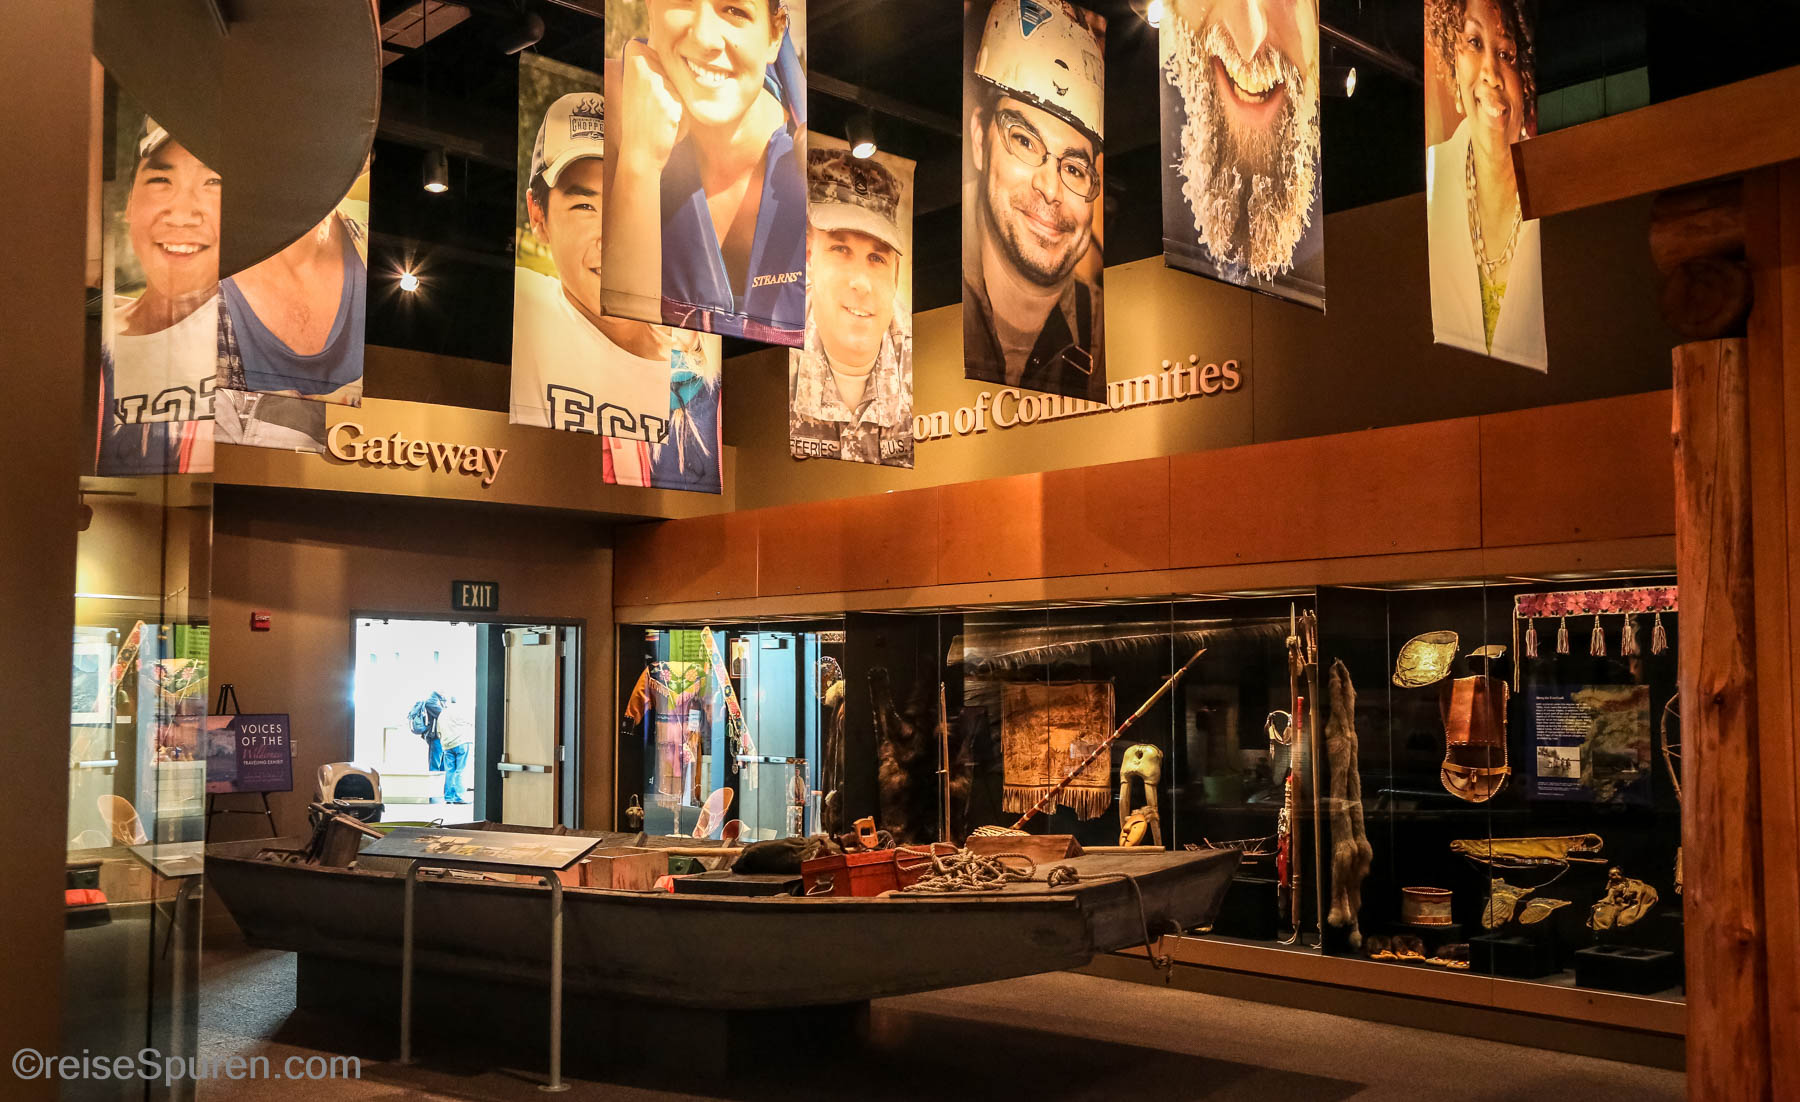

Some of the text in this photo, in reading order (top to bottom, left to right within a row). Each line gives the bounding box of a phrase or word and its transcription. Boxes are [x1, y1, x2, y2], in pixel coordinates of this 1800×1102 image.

[752, 271, 799, 288] STEARNS
[953, 391, 992, 433] of
[327, 421, 508, 485] Gateway
[888, 439, 908, 455] U.S.
[462, 584, 492, 608] EXIT
[241, 723, 282, 734] VOICES
[241, 736, 284, 746] OF THE
